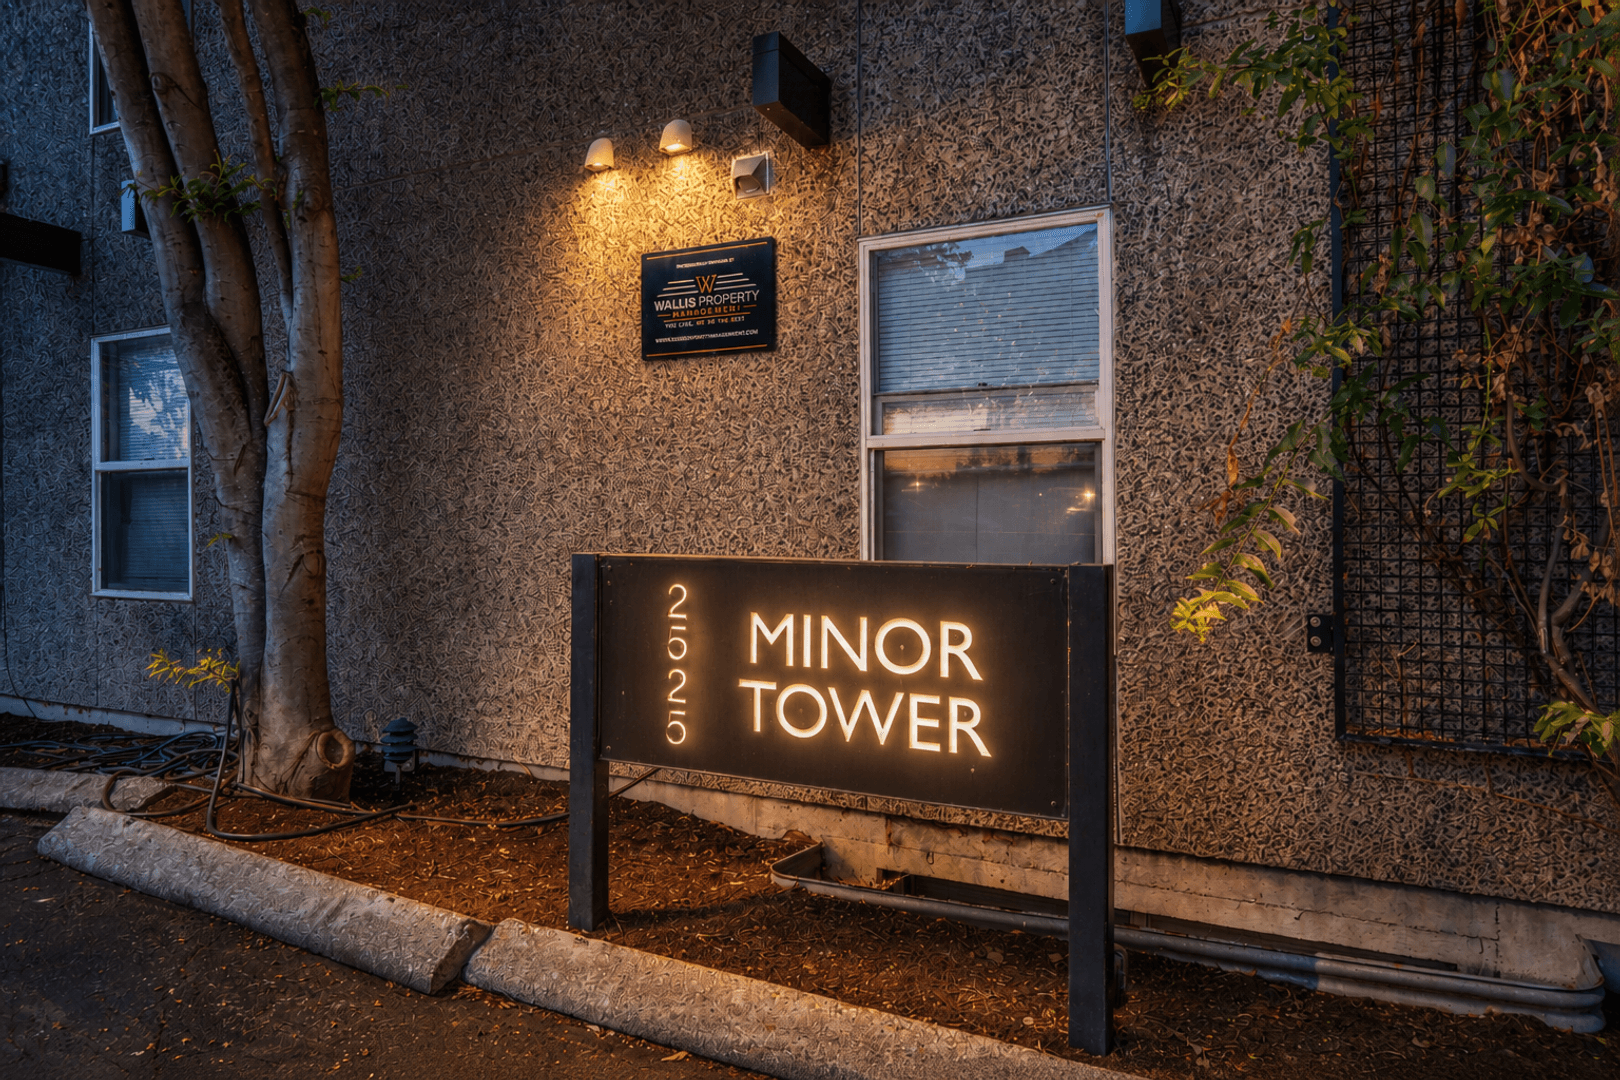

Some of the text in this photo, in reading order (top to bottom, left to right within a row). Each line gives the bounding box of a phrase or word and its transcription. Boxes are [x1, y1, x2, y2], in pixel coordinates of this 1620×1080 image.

[653, 289, 760, 312] WALLIS PROPERTY
[695, 274, 717, 294] W
[750, 611, 984, 681] MINOR
[738, 678, 992, 758] TOWER
